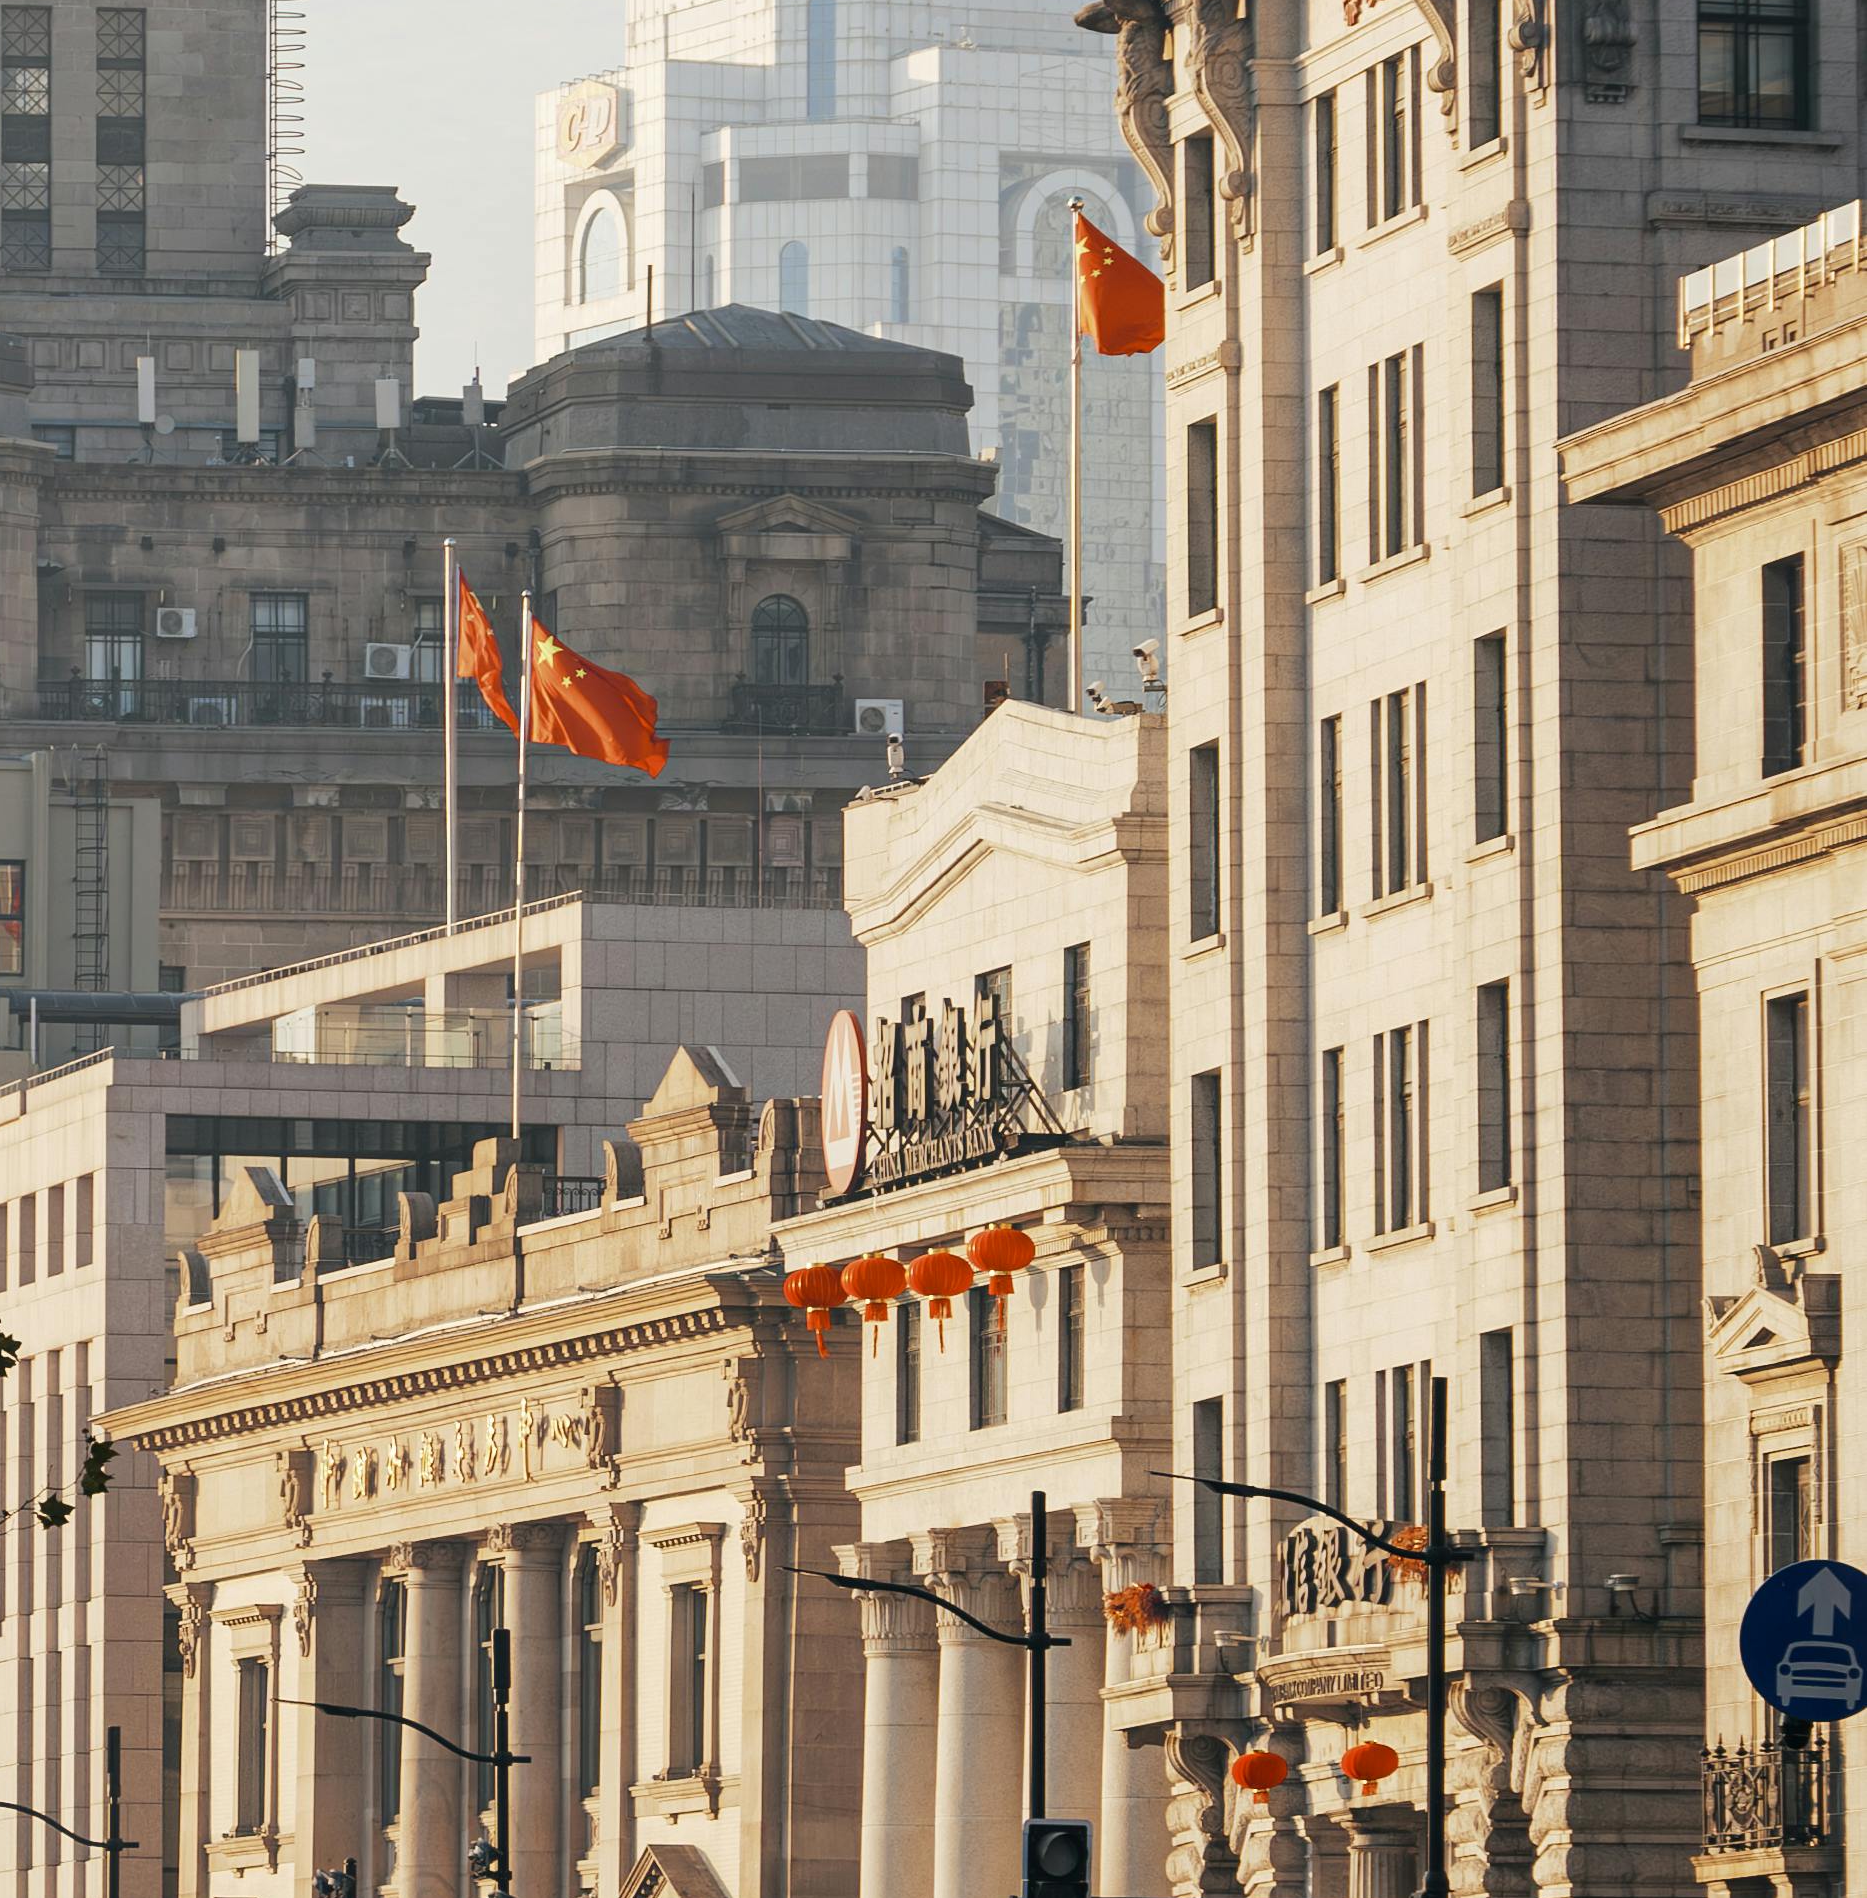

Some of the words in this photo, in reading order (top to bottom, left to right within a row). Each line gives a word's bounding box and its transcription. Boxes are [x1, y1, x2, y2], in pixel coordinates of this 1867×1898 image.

[871, 1151, 902, 1183] CHINA
[904, 1133, 964, 1175] MERCHANTS
[966, 1123, 995, 1159] BANK
[1337, 1671, 1384, 1693] LIMITED
